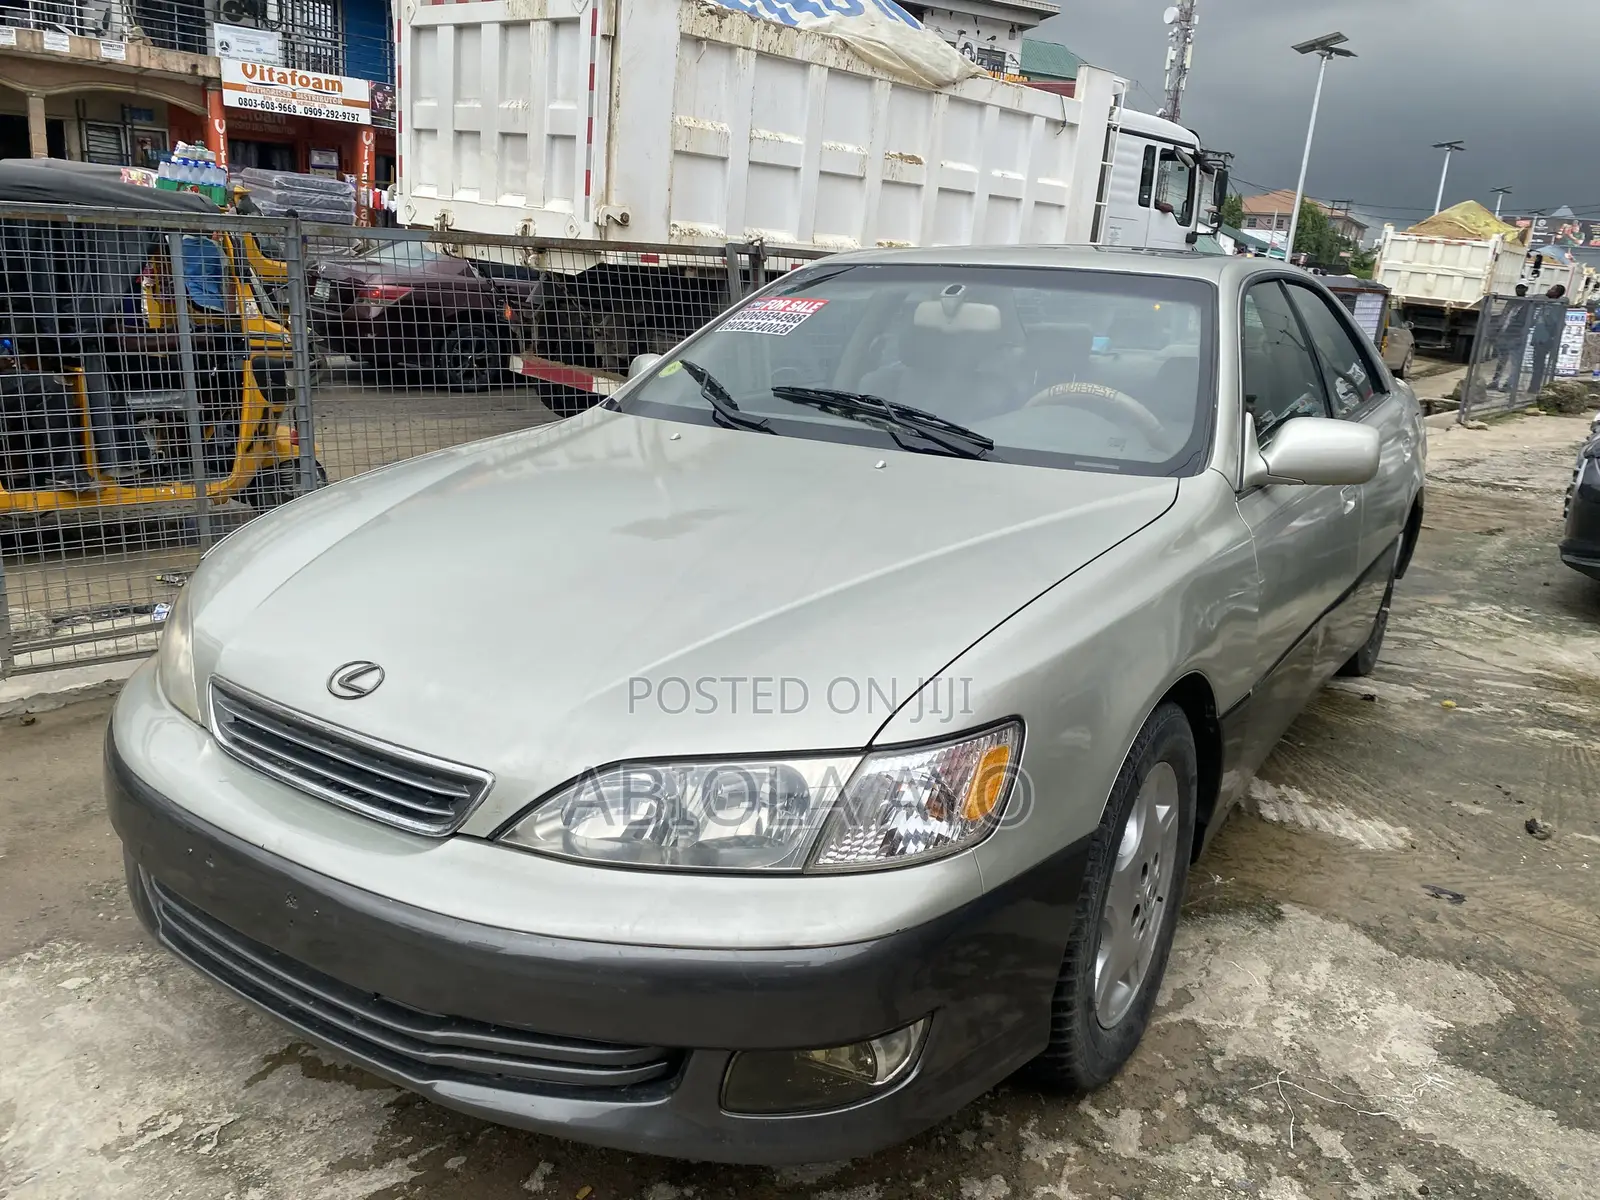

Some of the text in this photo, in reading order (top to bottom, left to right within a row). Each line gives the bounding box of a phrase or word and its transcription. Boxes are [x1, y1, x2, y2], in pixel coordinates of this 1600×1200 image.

[241, 62, 343, 92] Vitafoam
[245, 85, 343, 105] AUTHORISED DISTRIBUTOR
[759, 299, 825, 314] FOR SALE
